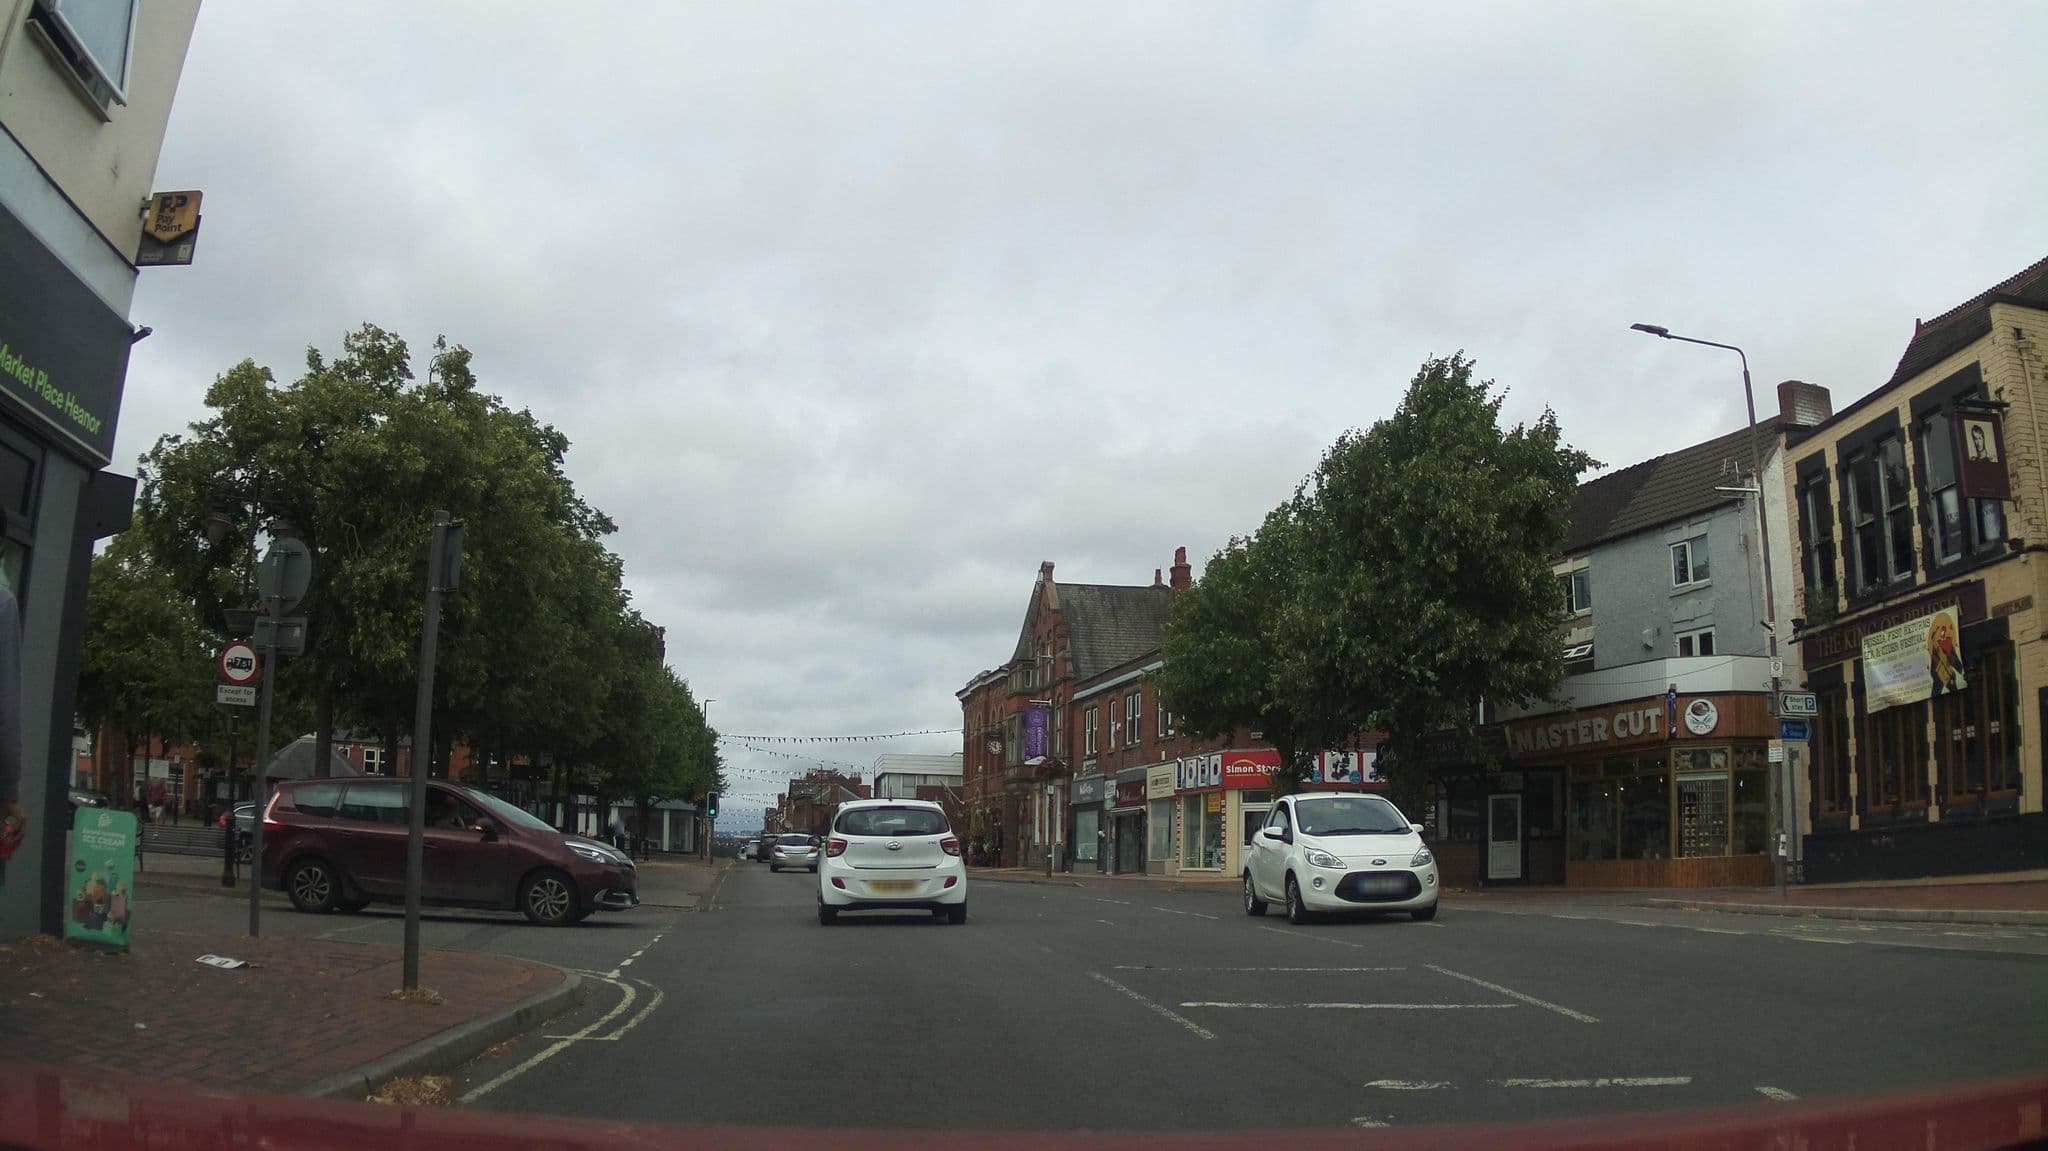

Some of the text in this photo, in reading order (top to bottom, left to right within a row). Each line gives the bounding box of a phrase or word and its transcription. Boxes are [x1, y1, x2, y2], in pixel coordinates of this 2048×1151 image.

[156, 214, 176, 225] Pay
[154, 223, 184, 233] Point
[34, 369, 65, 410] Place
[63, 391, 102, 435] Heanor
[1816, 631, 1842, 658] THE
[219, 687, 254, 697] Except for
[1789, 696, 1804, 704] Short
[1791, 704, 1804, 712] stay
[1514, 707, 1663, 753] MASTER CUT
[1226, 763, 1254, 774] Simon
[82, 834, 97, 844] ICE
[97, 836, 125, 849] CREAM
